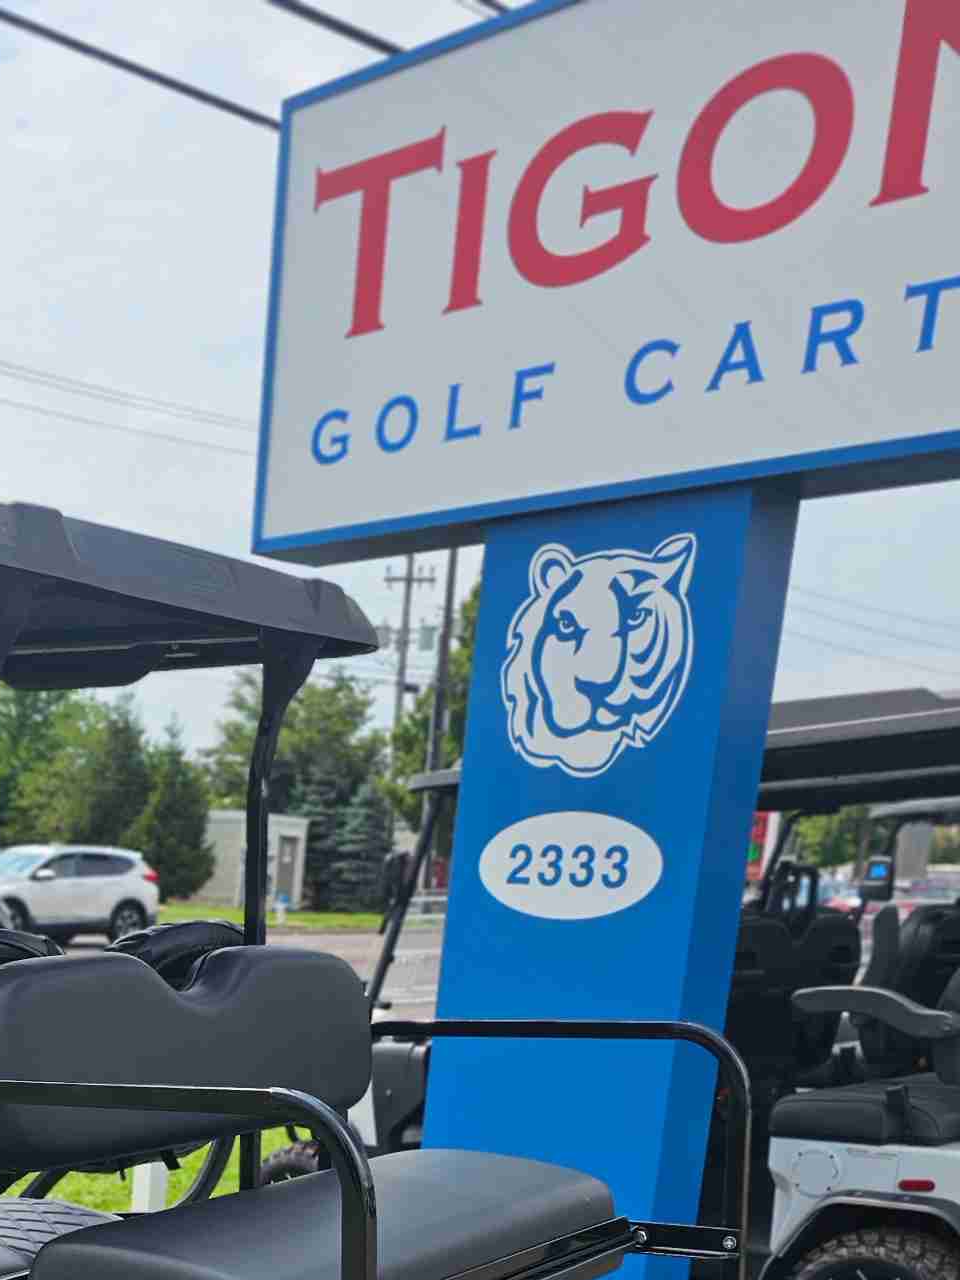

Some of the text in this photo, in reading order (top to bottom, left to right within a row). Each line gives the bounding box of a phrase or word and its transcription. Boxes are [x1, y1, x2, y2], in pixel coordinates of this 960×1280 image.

[309, 276, 960, 466] GOLF CART
[506, 843, 630, 889] 2333
